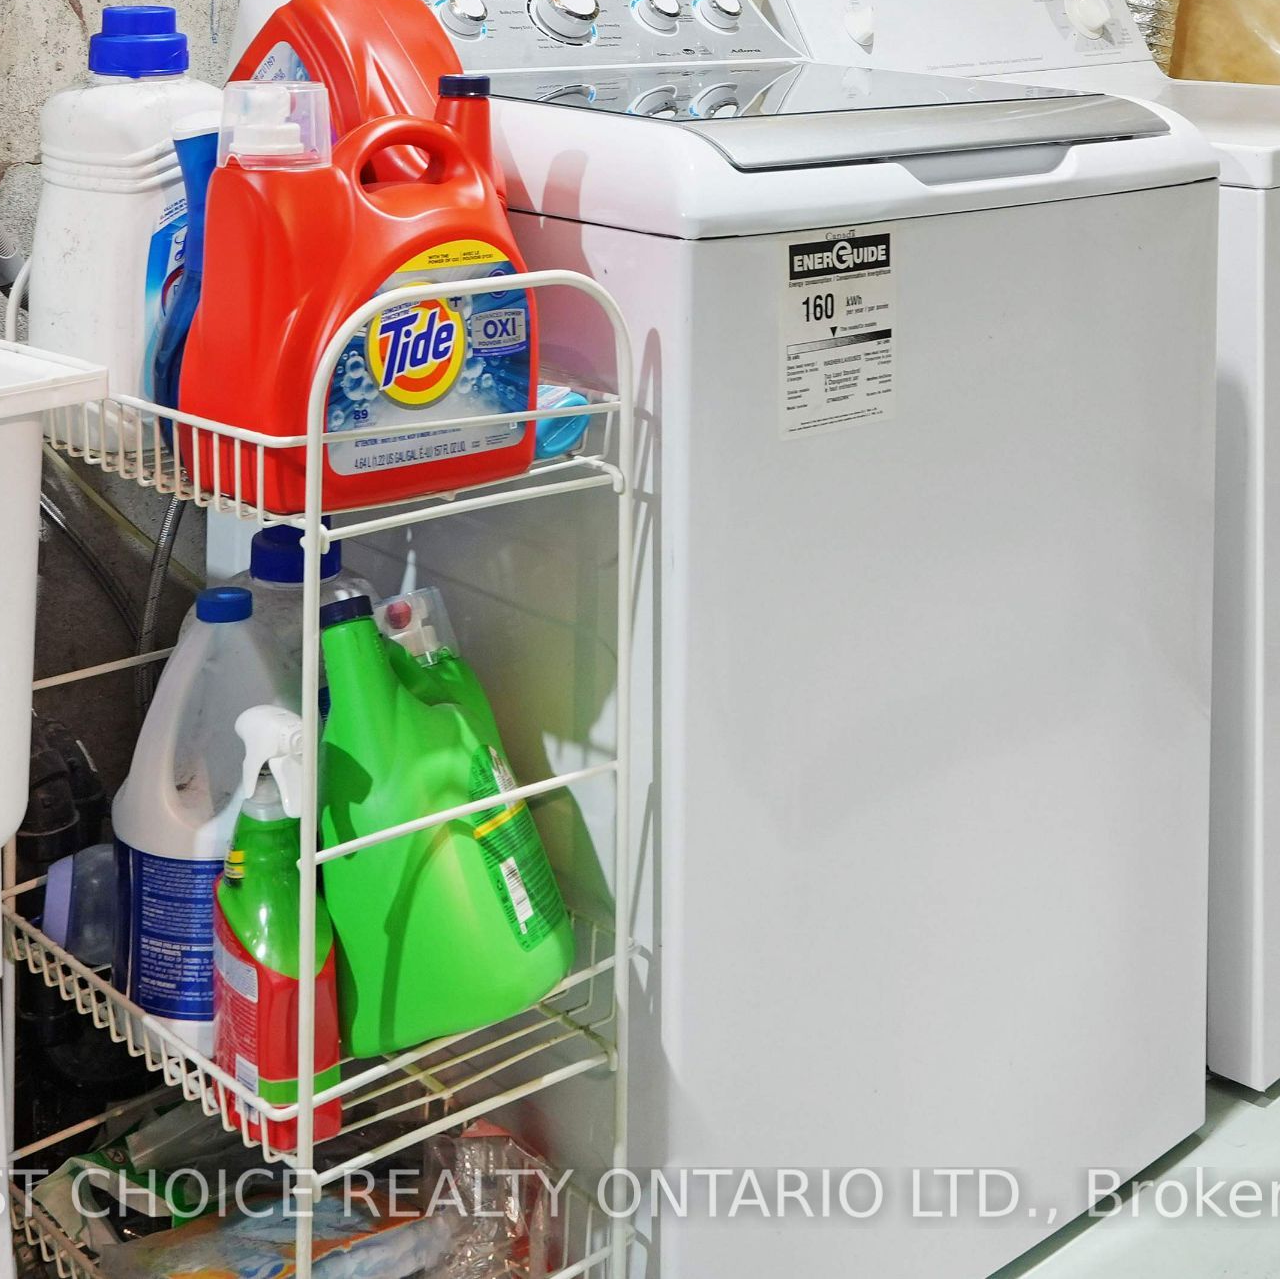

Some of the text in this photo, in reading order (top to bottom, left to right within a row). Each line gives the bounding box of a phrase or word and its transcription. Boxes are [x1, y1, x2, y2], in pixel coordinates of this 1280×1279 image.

[825, 229, 856, 241] Canada
[802, 292, 834, 322] 160
[846, 294, 863, 307] kWh
[483, 317, 517, 339] OXI
[379, 307, 456, 392] Tide
[353, 409, 369, 421] 89
